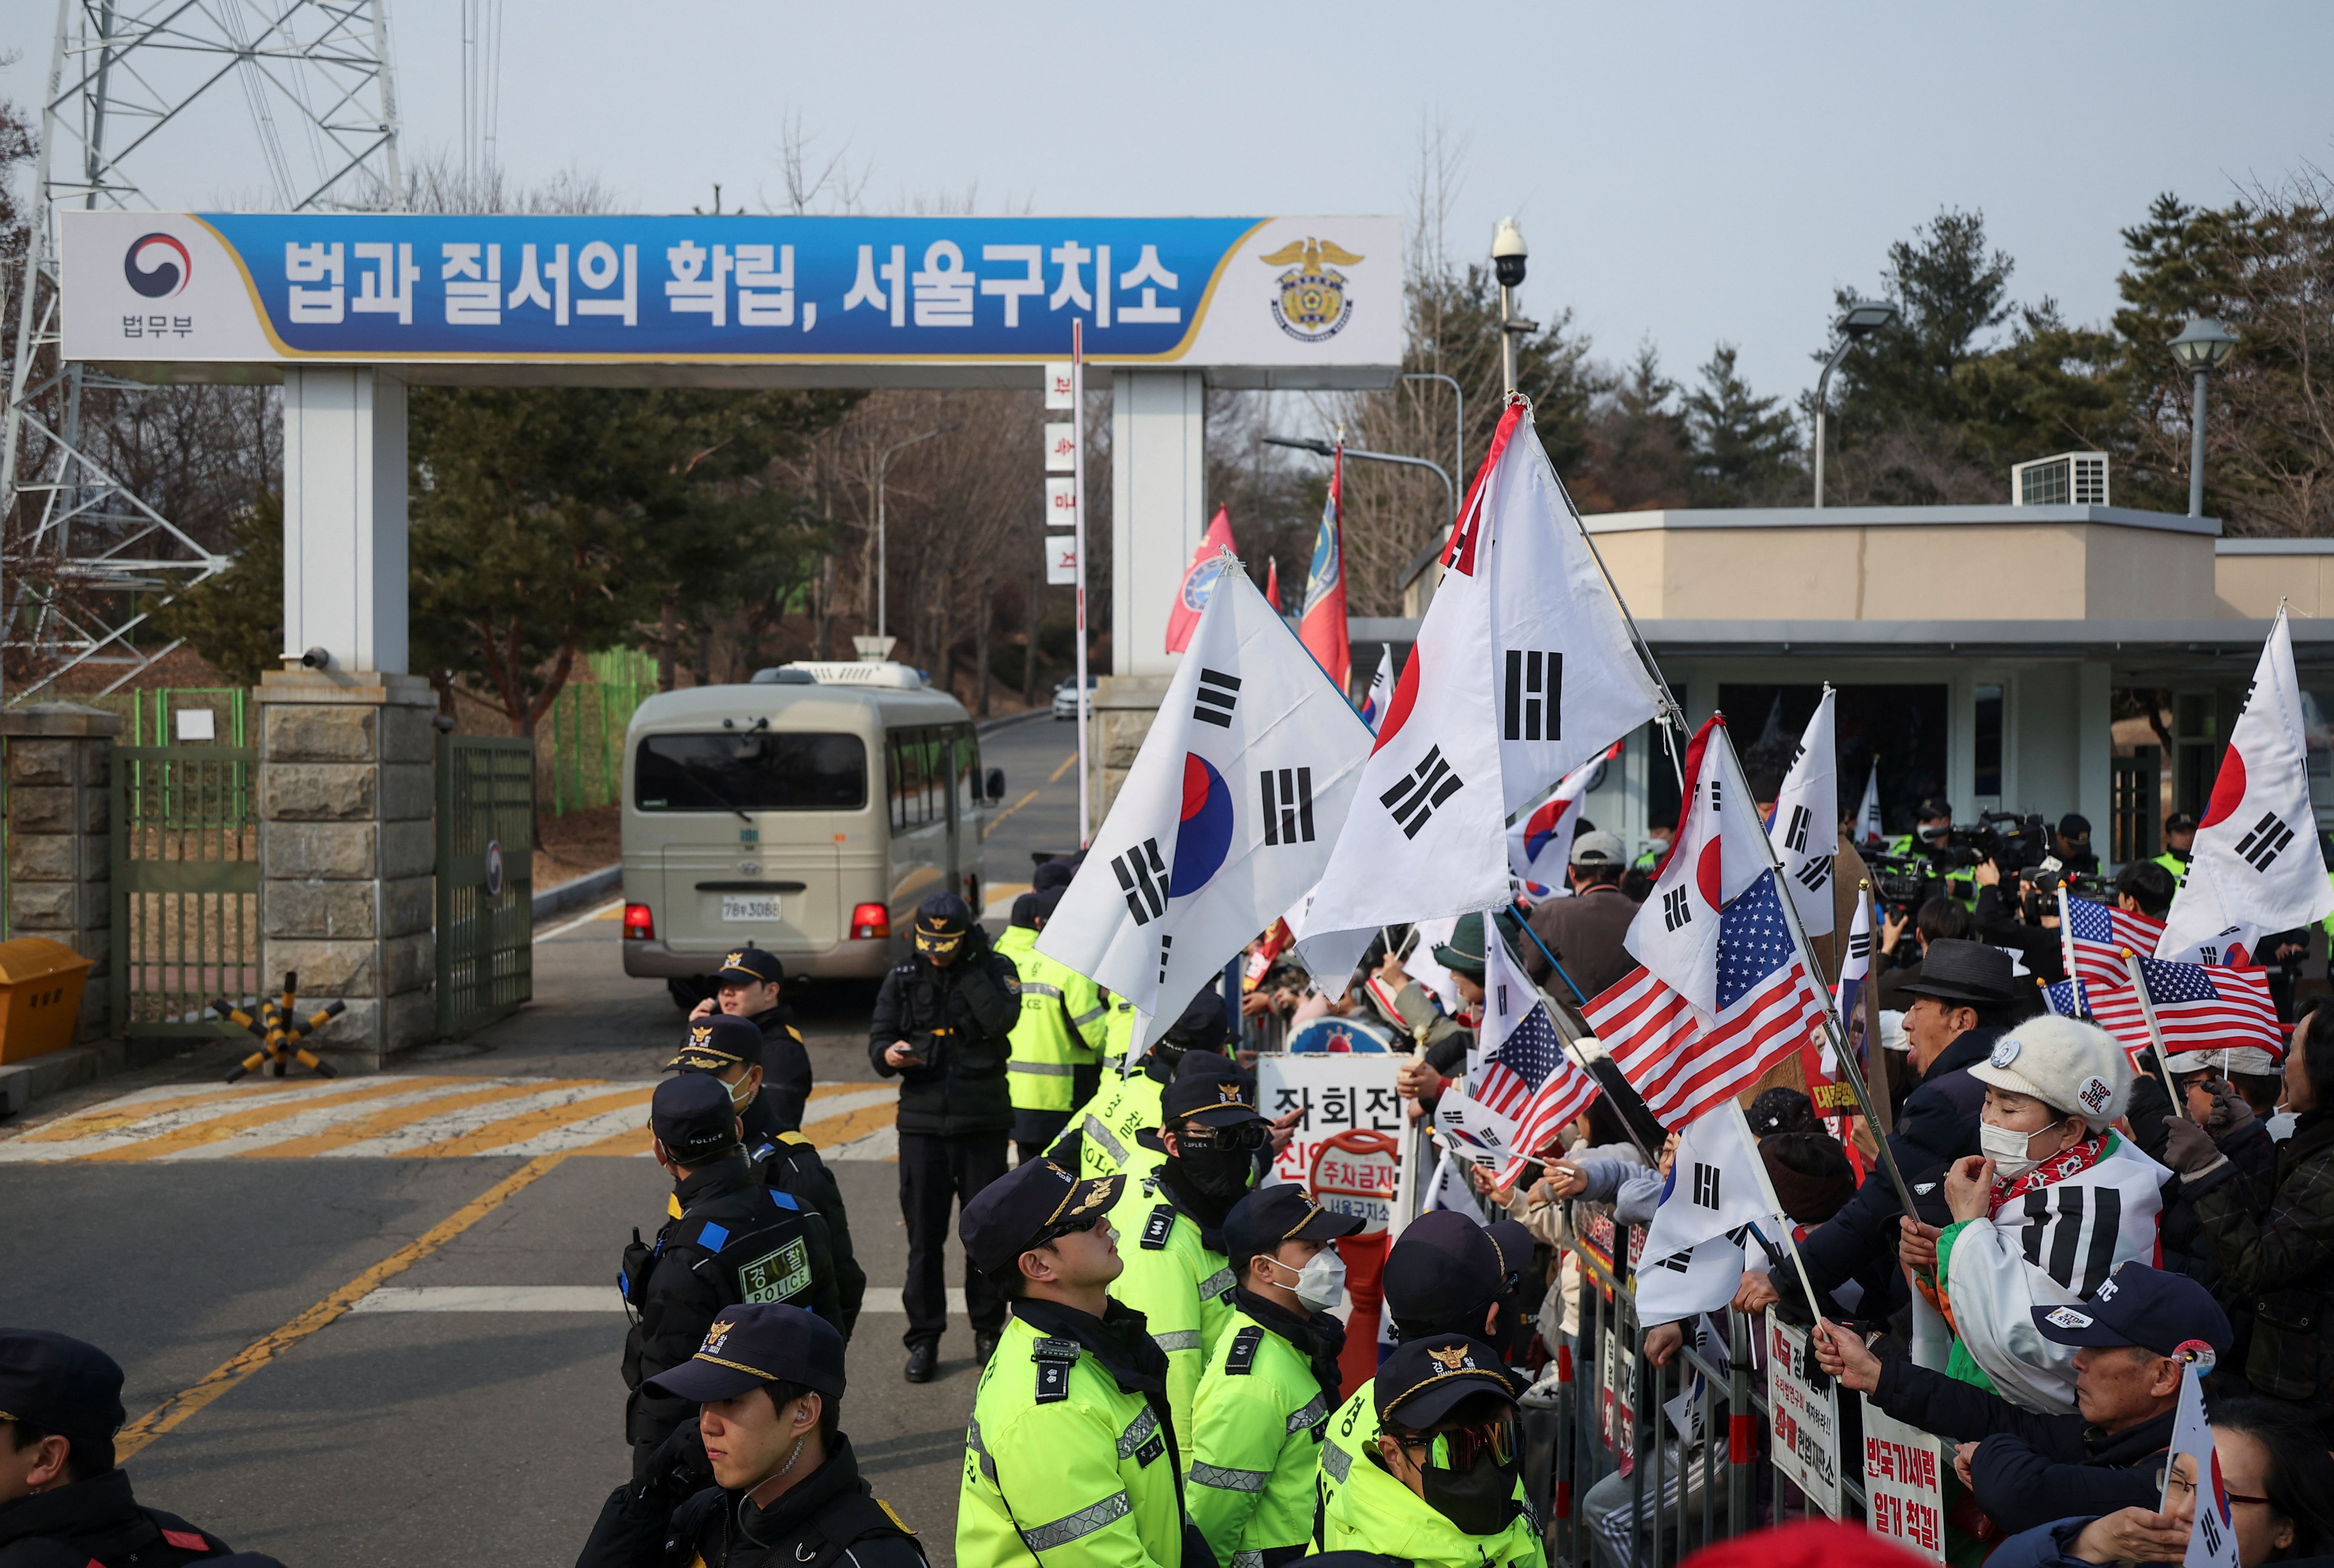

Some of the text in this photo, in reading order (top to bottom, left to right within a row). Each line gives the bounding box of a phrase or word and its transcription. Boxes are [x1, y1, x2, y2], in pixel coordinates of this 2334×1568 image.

[286, 242, 419, 325] 법과
[442, 242, 637, 325] 질서의
[665, 240, 816, 332] 확립,
[844, 240, 1180, 328] 서울구치소
[123, 314, 194, 338] 법무부
[2089, 1087, 2105, 1104] THE
[2091, 1079, 2111, 1097] STOP
[2080, 1091, 2102, 1114] STEAL
[690, 1133, 723, 1144] POLICE
[1324, 1161, 1392, 1190] 주차금지
[1330, 1198, 1389, 1222] 서울구치소
[750, 1248, 802, 1289] 경찰
[754, 1271, 805, 1303] POLICE
[2057, 1316, 2072, 1326] STE
[2063, 1313, 2085, 1324] STOP
[1867, 1437, 1937, 1494] 반국가세력
[1874, 1492, 1939, 1552] 일거 척결!
